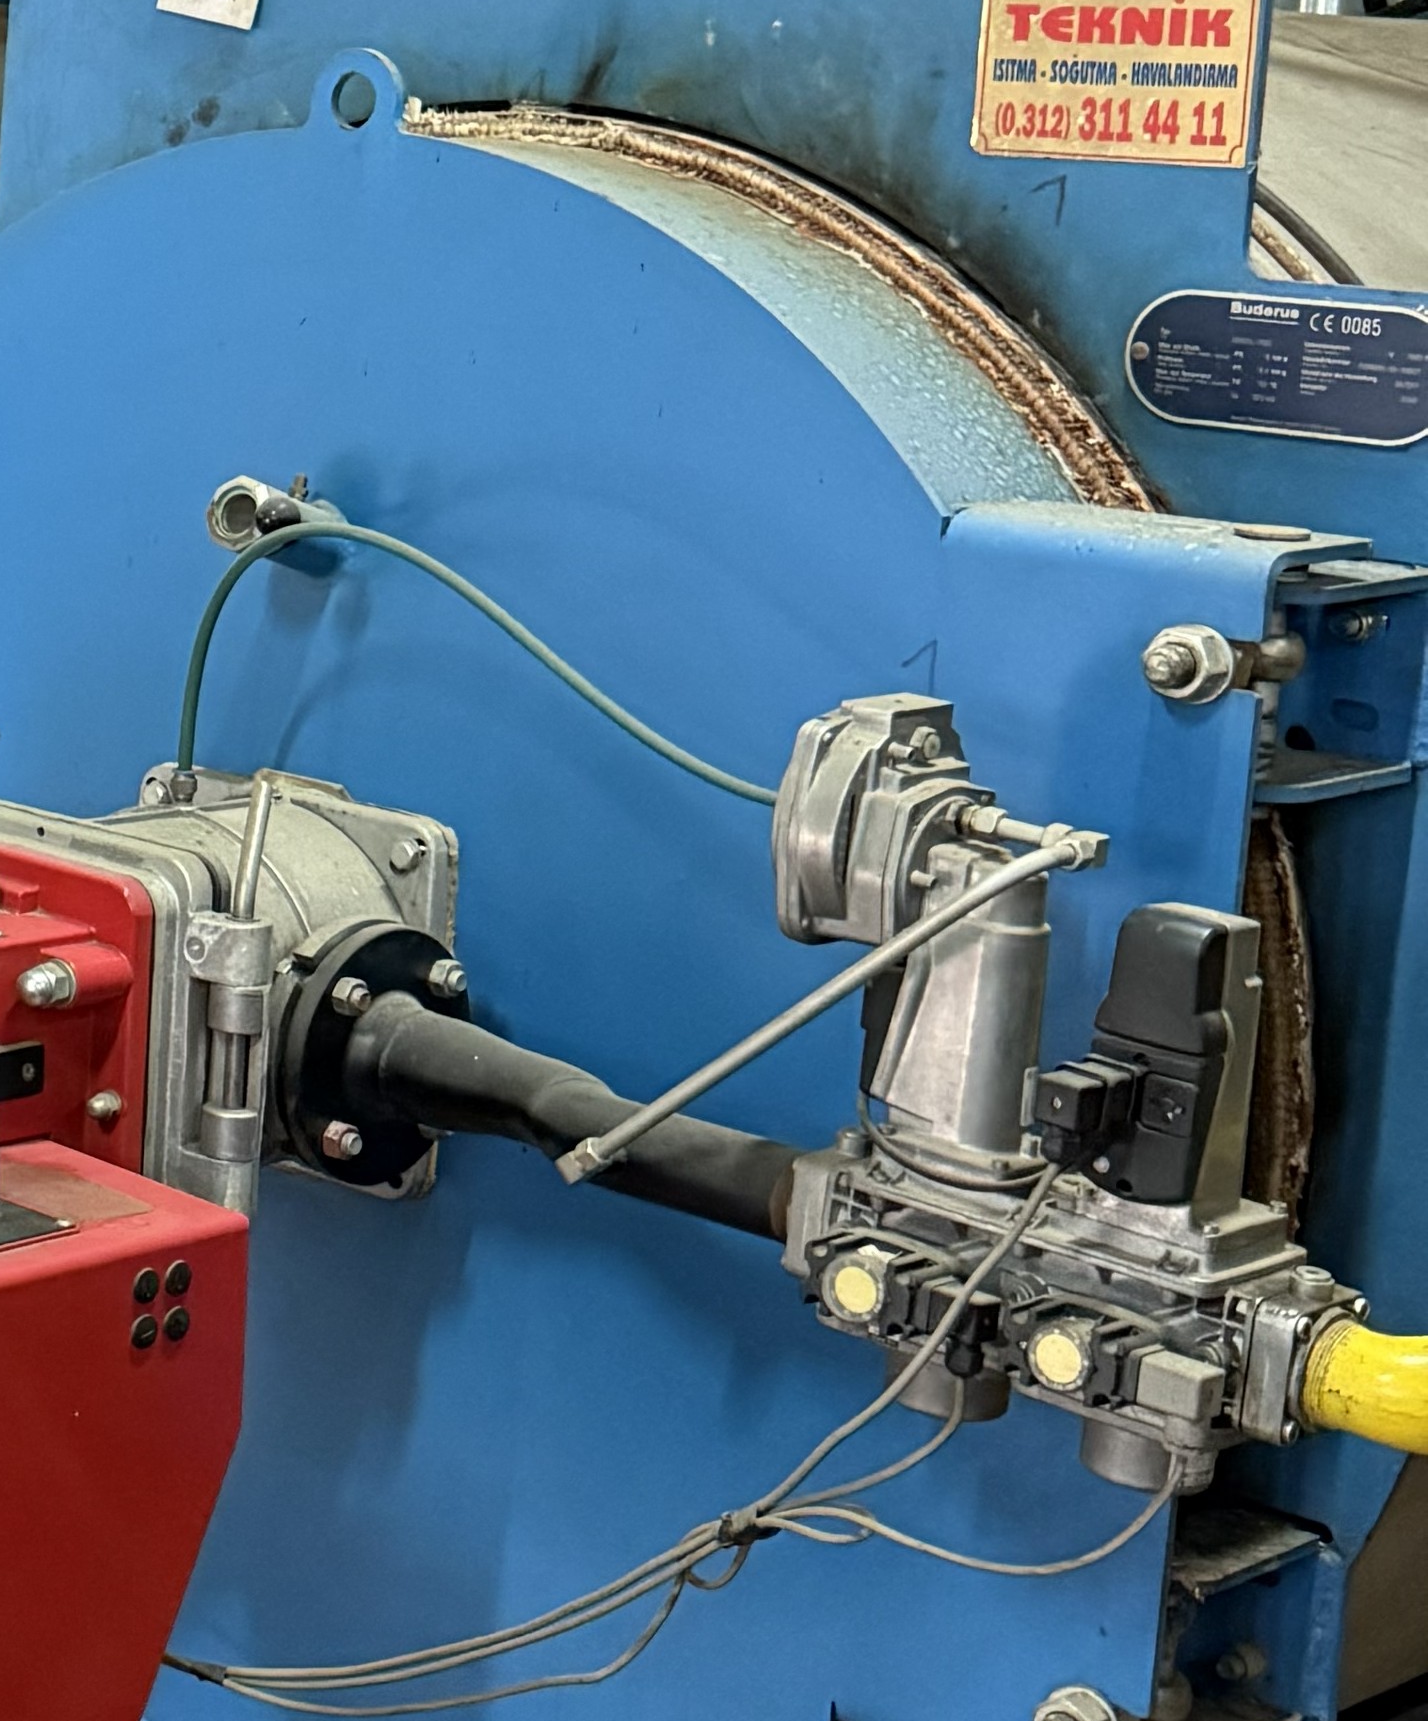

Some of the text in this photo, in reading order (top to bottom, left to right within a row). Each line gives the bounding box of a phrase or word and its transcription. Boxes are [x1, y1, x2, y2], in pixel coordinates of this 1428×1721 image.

[993, 53, 1239, 89] ISITMA SOĞUTMA HAVALANDIRMA
[996, 96, 1227, 146] (0.312) 311 44 11
[1230, 300, 1300, 320] Buderus
[1341, 314, 1382, 337] 0085
